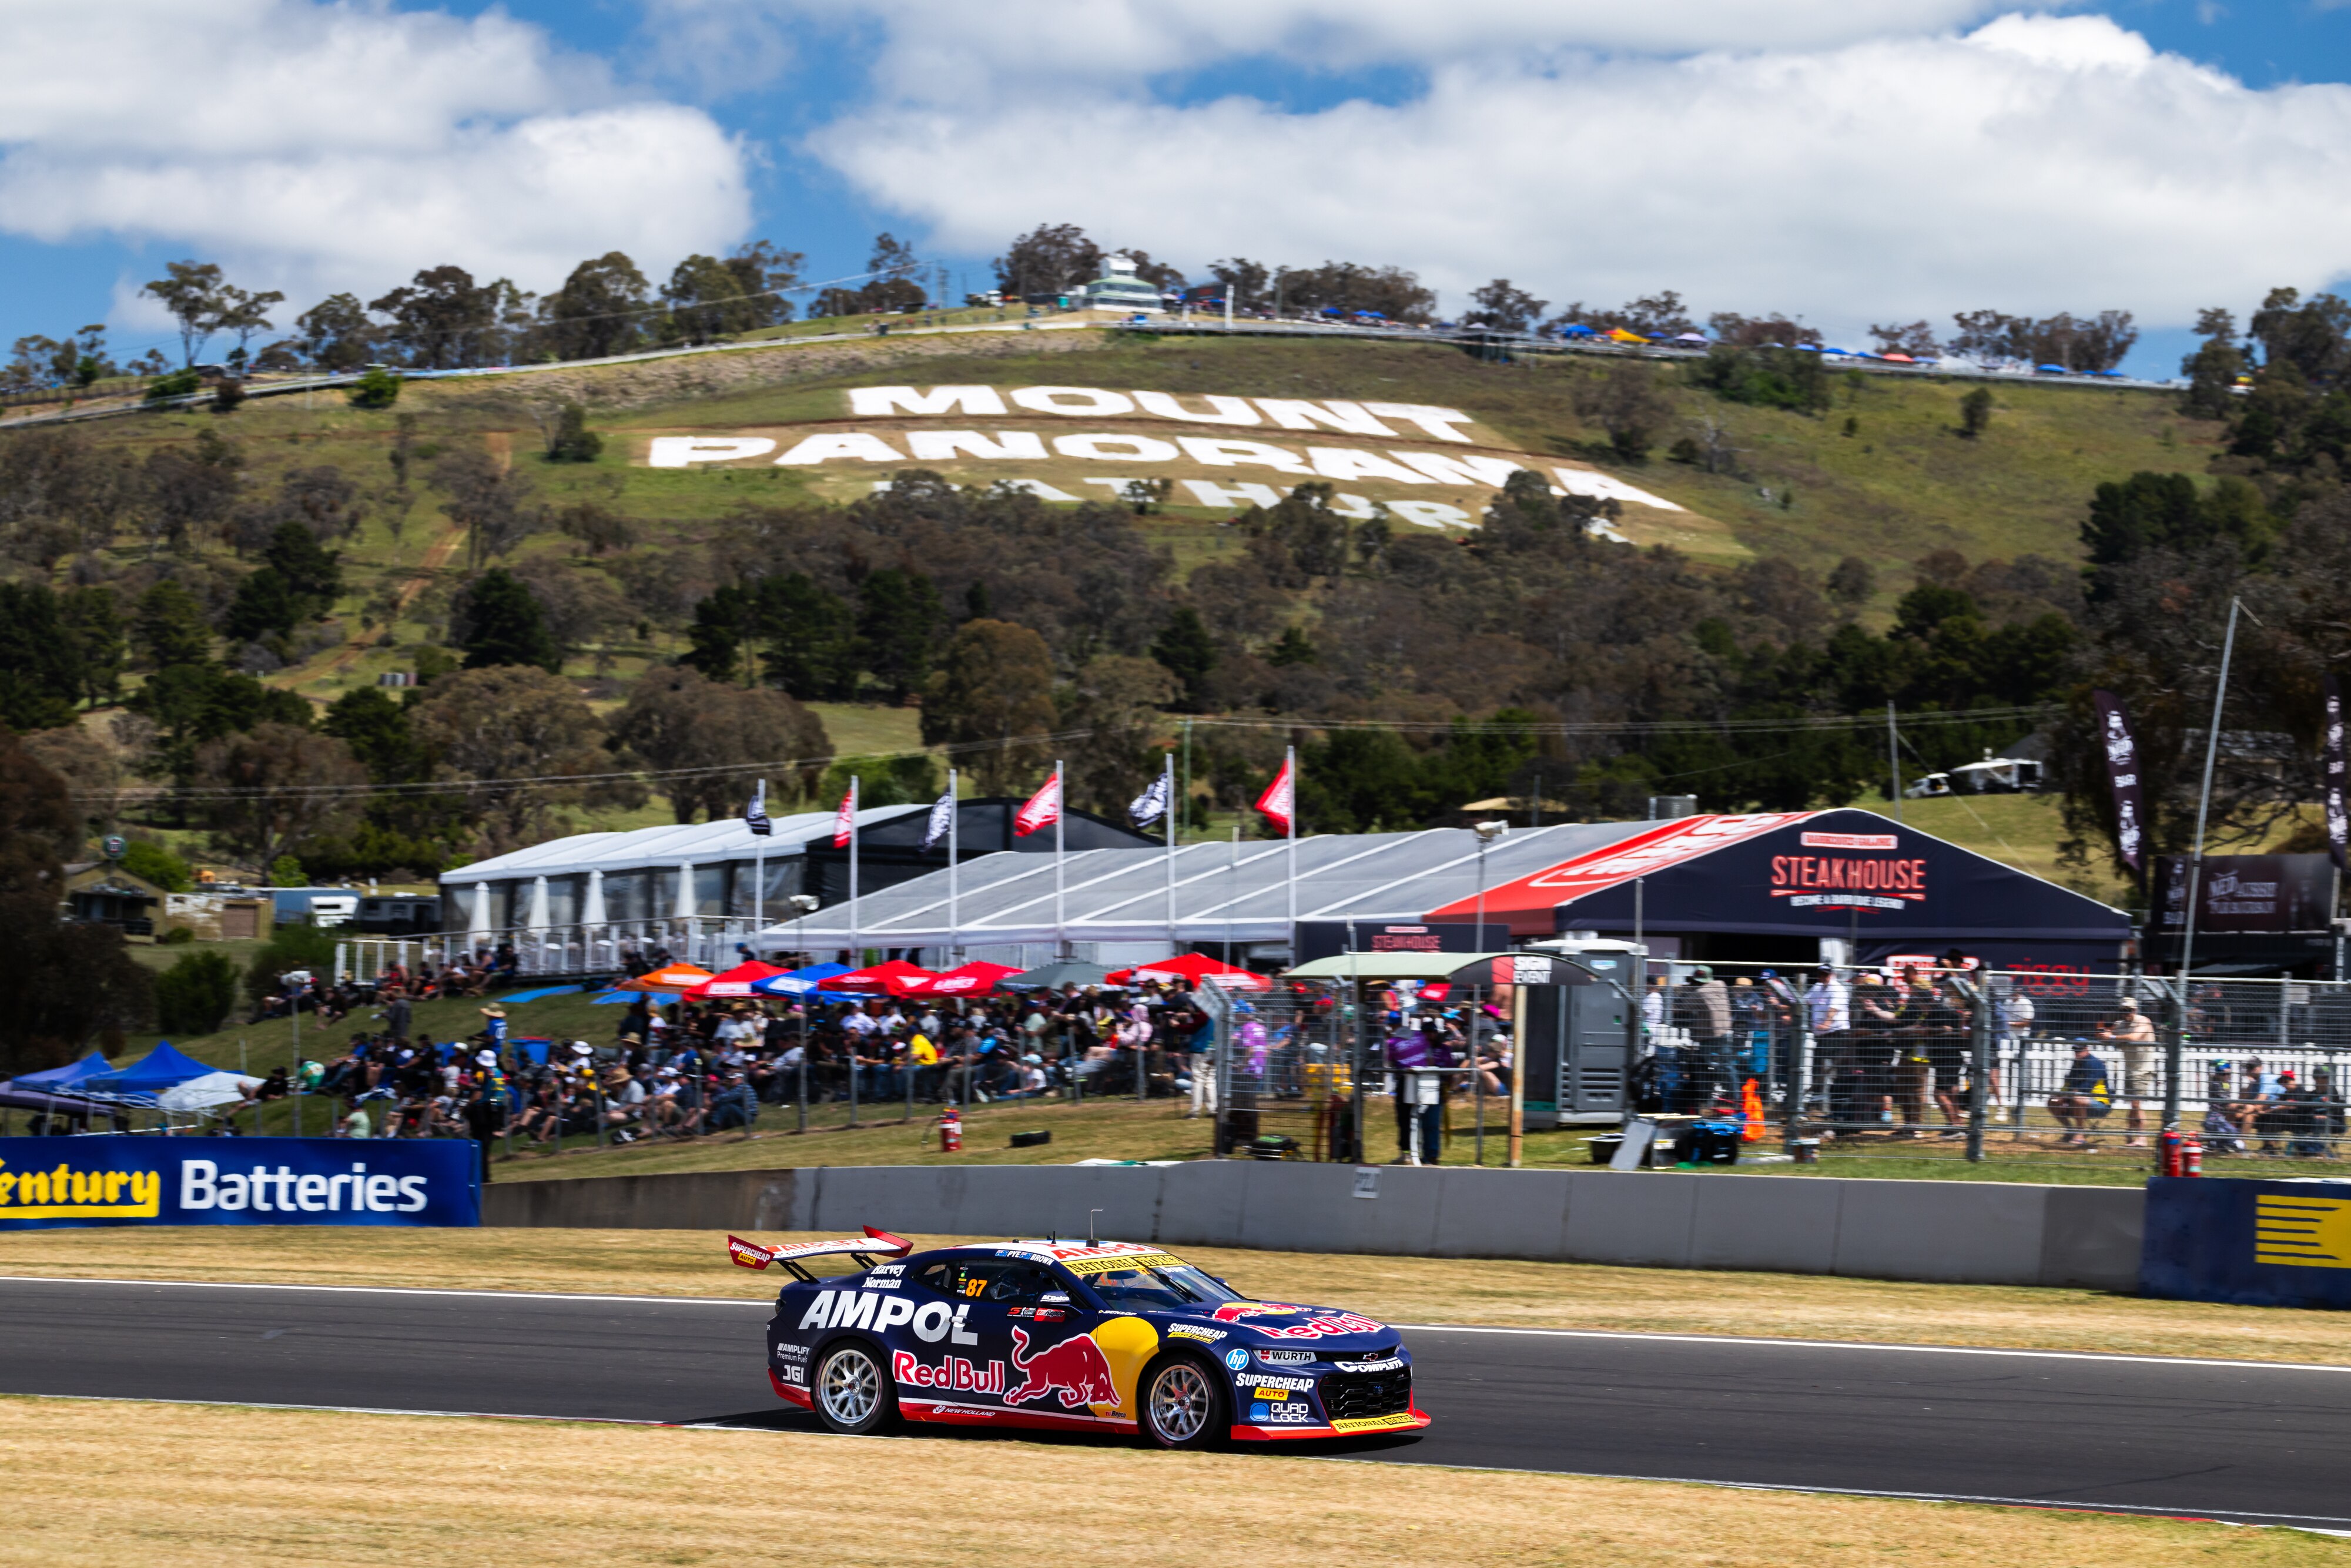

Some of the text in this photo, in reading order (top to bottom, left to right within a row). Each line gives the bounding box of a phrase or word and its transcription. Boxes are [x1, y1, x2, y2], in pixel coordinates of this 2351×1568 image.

[849, 384, 1473, 443] MOUNT
[648, 430, 1686, 511] PANORAMA
[1770, 855, 1927, 890] STEAKHOUSE
[0, 1157, 428, 1218] entury Batteries
[730, 1241, 771, 1262] SUPERCHEAP
[739, 1254, 755, 1263] AUTO
[1006, 1250, 1055, 1267] PYE BROWN
[870, 1265, 906, 1277] Harvey
[1066, 1258, 1138, 1274] NATIONAL
[862, 1276, 902, 1289] Norman
[966, 1278, 987, 1297] 87
[798, 1290, 978, 1346] AMPOL
[1044, 1309, 1066, 1318] Repco
[1167, 1322, 1228, 1340] SUPERCHEAP
[1190, 1335, 1213, 1343] TRADE
[777, 1351, 808, 1363] Premium Fuels
[782, 1343, 810, 1355] AMPLIFY
[1272, 1352, 1312, 1361] WÜRTH
[1229, 1351, 1247, 1369] hp
[1334, 1359, 1404, 1373] COMPLETE
[782, 1364, 804, 1383] JGI
[893, 1349, 1005, 1395] Red Bull
[1235, 1372, 1314, 1392] SUPERCHEAP
[1258, 1390, 1285, 1398] AUTO
[1271, 1402, 1308, 1413] QUAD
[1270, 1413, 1309, 1422] LOCK
[1335, 1419, 1386, 1430] NATIONAL
